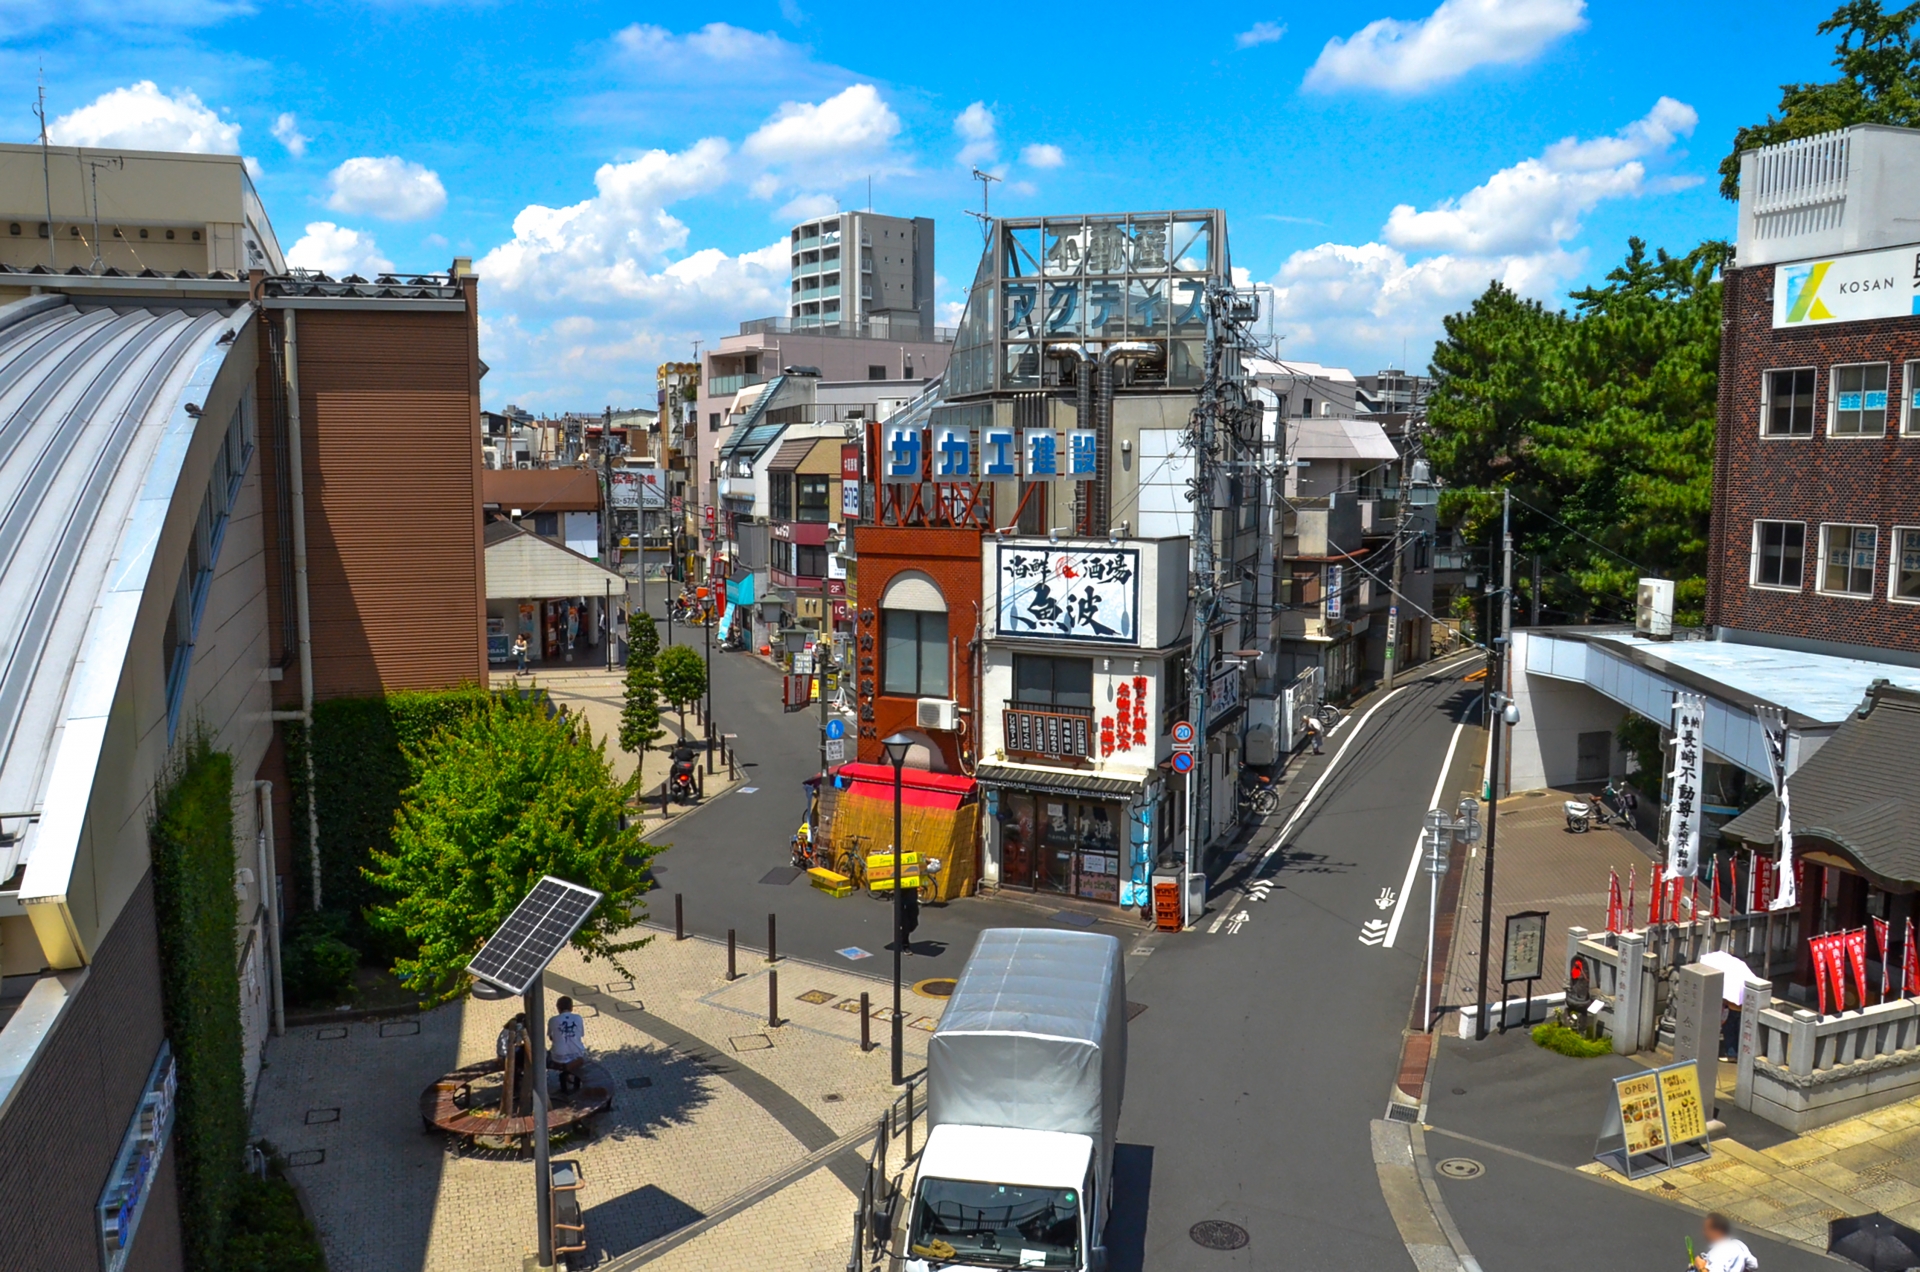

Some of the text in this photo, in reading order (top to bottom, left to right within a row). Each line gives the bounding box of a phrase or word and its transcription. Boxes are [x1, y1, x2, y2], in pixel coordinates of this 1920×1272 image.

[1047, 221, 1168, 271] 不動産
[1007, 280, 1206, 331] アクティス
[1839, 277, 1895, 294] KOSAN
[891, 429, 1097, 476] サカエ建設
[844, 486, 858, 509] ena
[1003, 551, 1133, 586] 海鮮 酒場
[1010, 583, 1122, 637] 魚波
[859, 607, 875, 723] サカエ建設
[1177, 727, 1190, 738] 20
[1676, 730, 1697, 819] 長崎不動尊
[1624, 1082, 1649, 1095] OPEN
